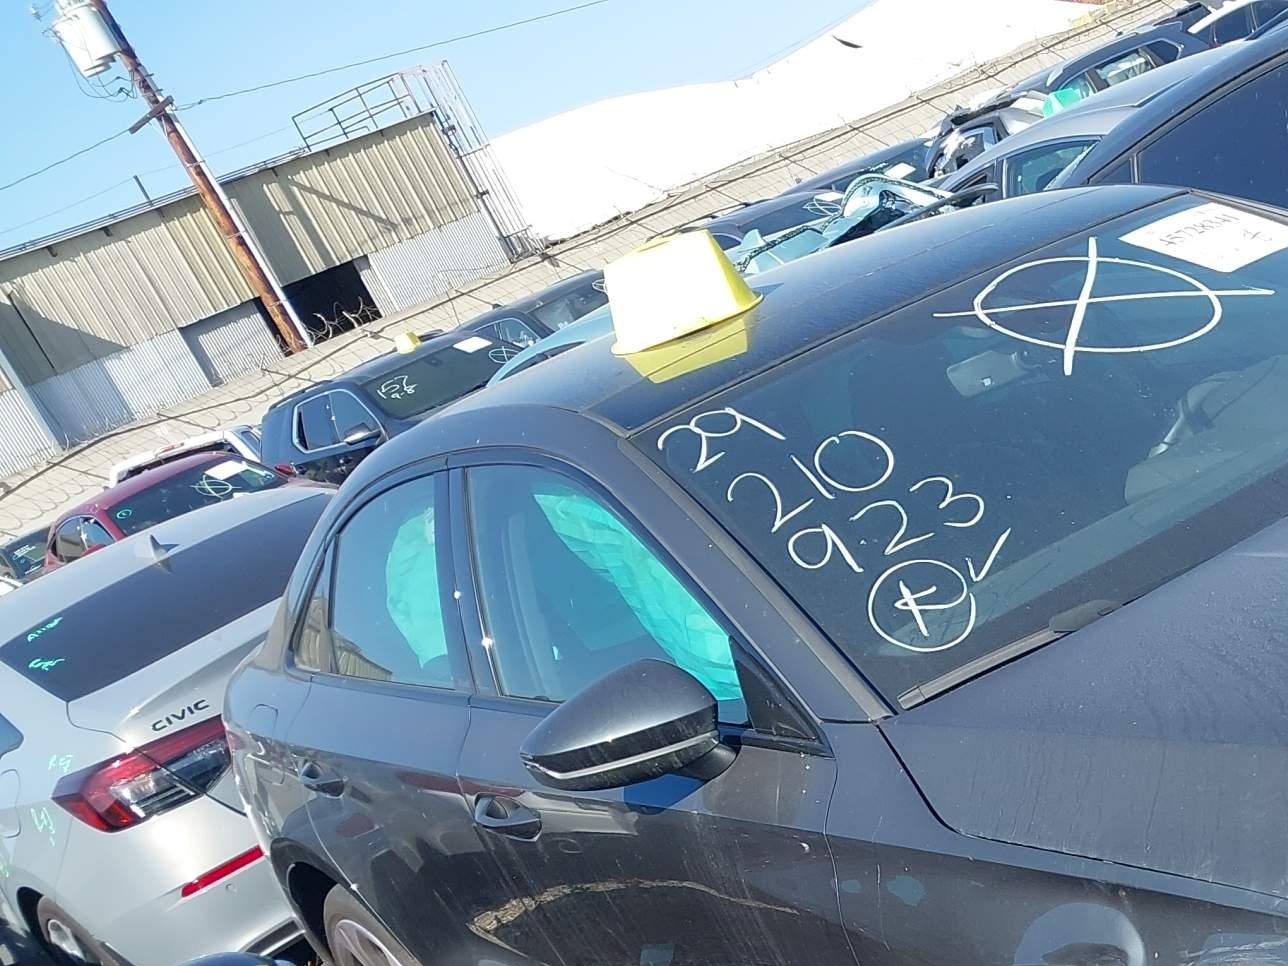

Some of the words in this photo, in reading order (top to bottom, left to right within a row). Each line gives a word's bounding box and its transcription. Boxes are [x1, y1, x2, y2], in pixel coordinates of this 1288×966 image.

[658, 407, 786, 473] 29
[727, 430, 894, 533] 210
[151, 699, 210, 731] CIVIC
